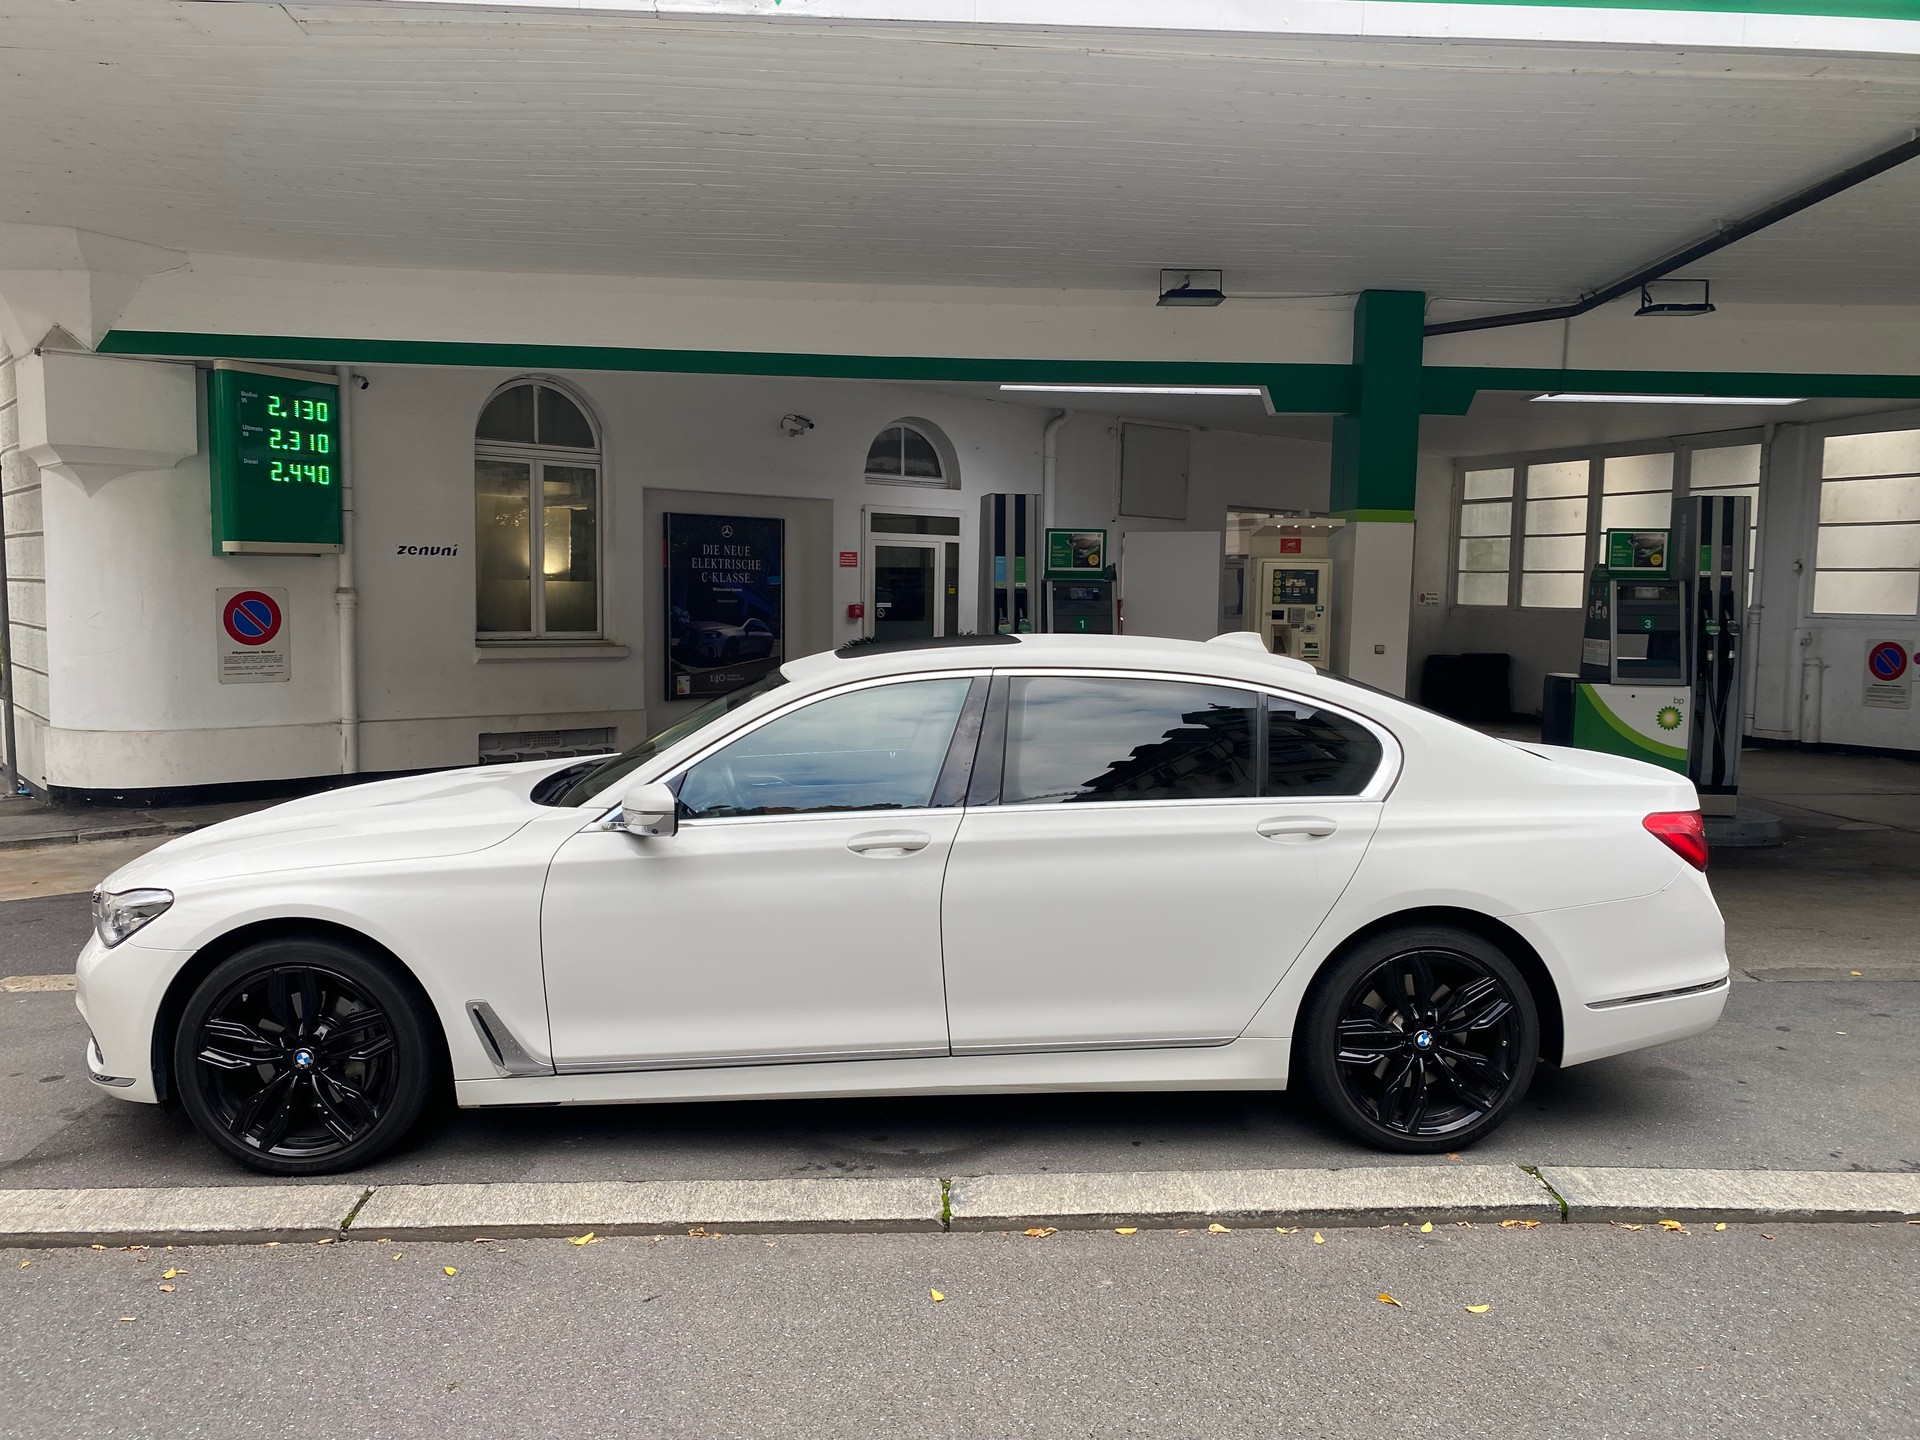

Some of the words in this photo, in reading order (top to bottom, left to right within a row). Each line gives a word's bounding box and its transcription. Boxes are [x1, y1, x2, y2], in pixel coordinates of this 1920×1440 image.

[268, 395, 328, 422] 2.130
[269, 428, 329, 454] 2.310
[270, 461, 330, 485] 2.440
[397, 544, 458, 556] zenuni
[703, 544, 720, 555] DIE
[724, 545, 751, 557] NEUE
[692, 557, 762, 571] ELEKTRISCHE
[701, 571, 754, 584] C-KLASSE.
[1080, 620, 1084, 629] 1
[1645, 620, 1652, 628] 3
[1673, 697, 1685, 705] bp
